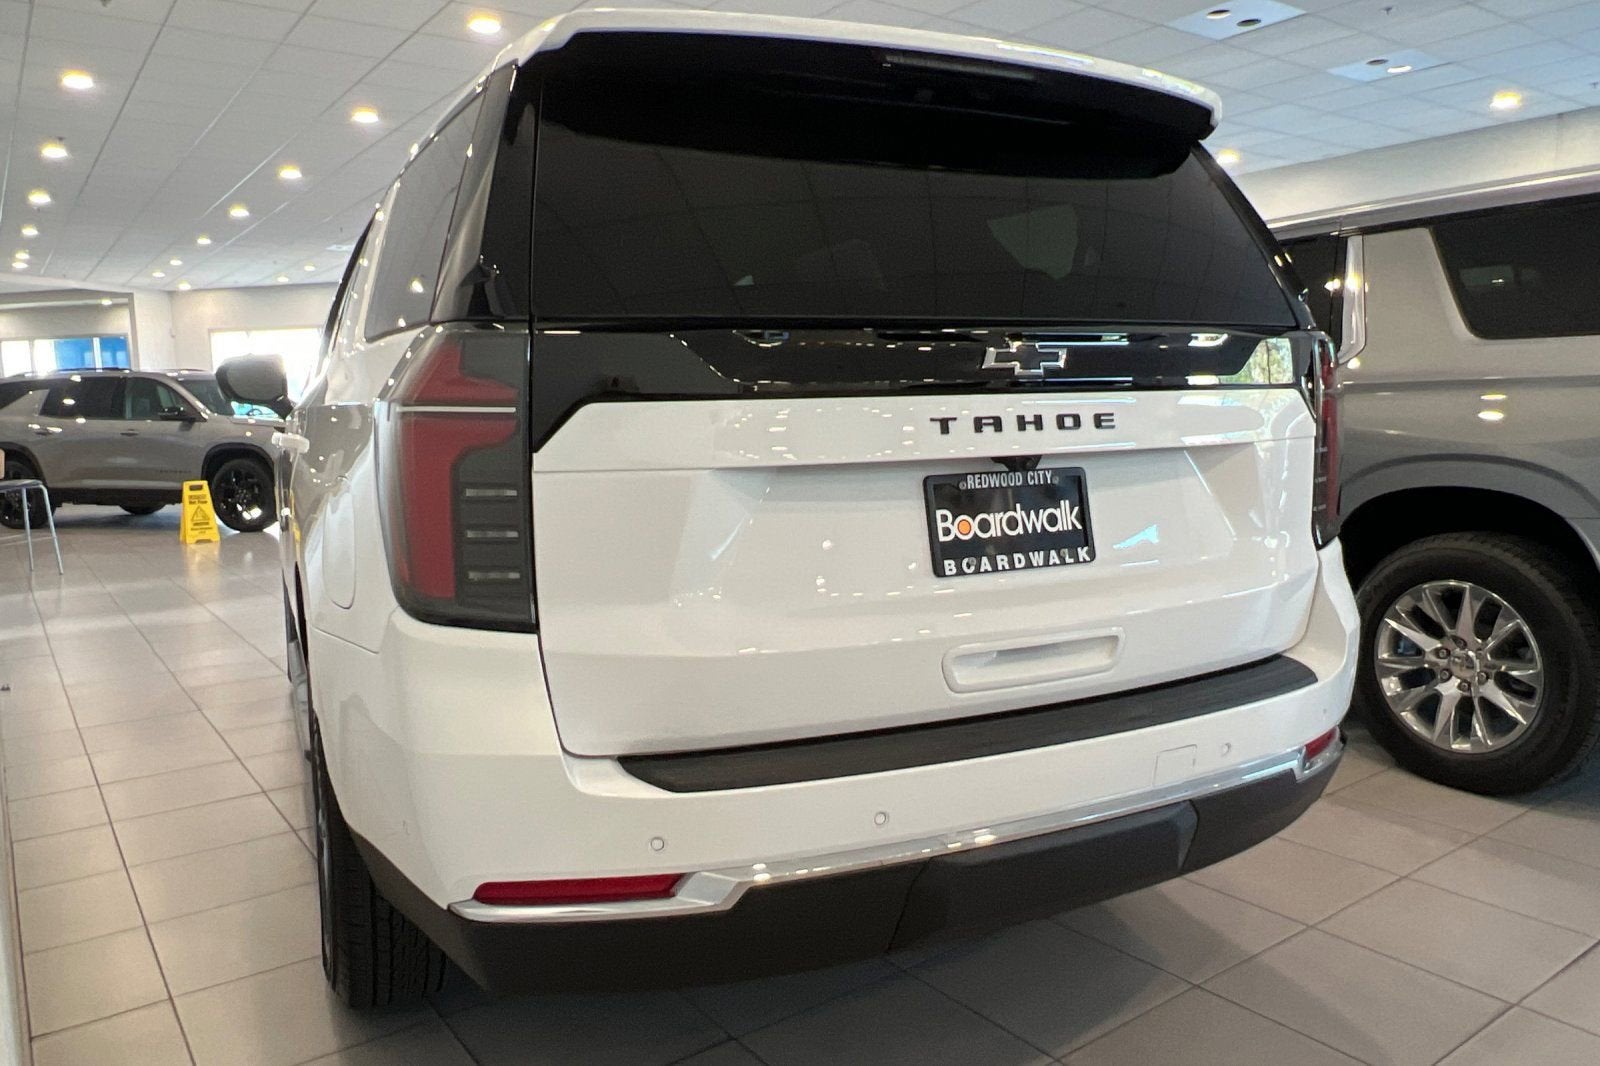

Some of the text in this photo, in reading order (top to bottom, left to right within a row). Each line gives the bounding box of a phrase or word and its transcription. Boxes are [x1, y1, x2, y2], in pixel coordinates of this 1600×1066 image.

[930, 412, 1115, 435] TAHOE
[966, 470, 1052, 490] REDWOOD CITY
[935, 499, 1083, 542] Boardwalk
[943, 546, 1091, 576] BOARDWALK
